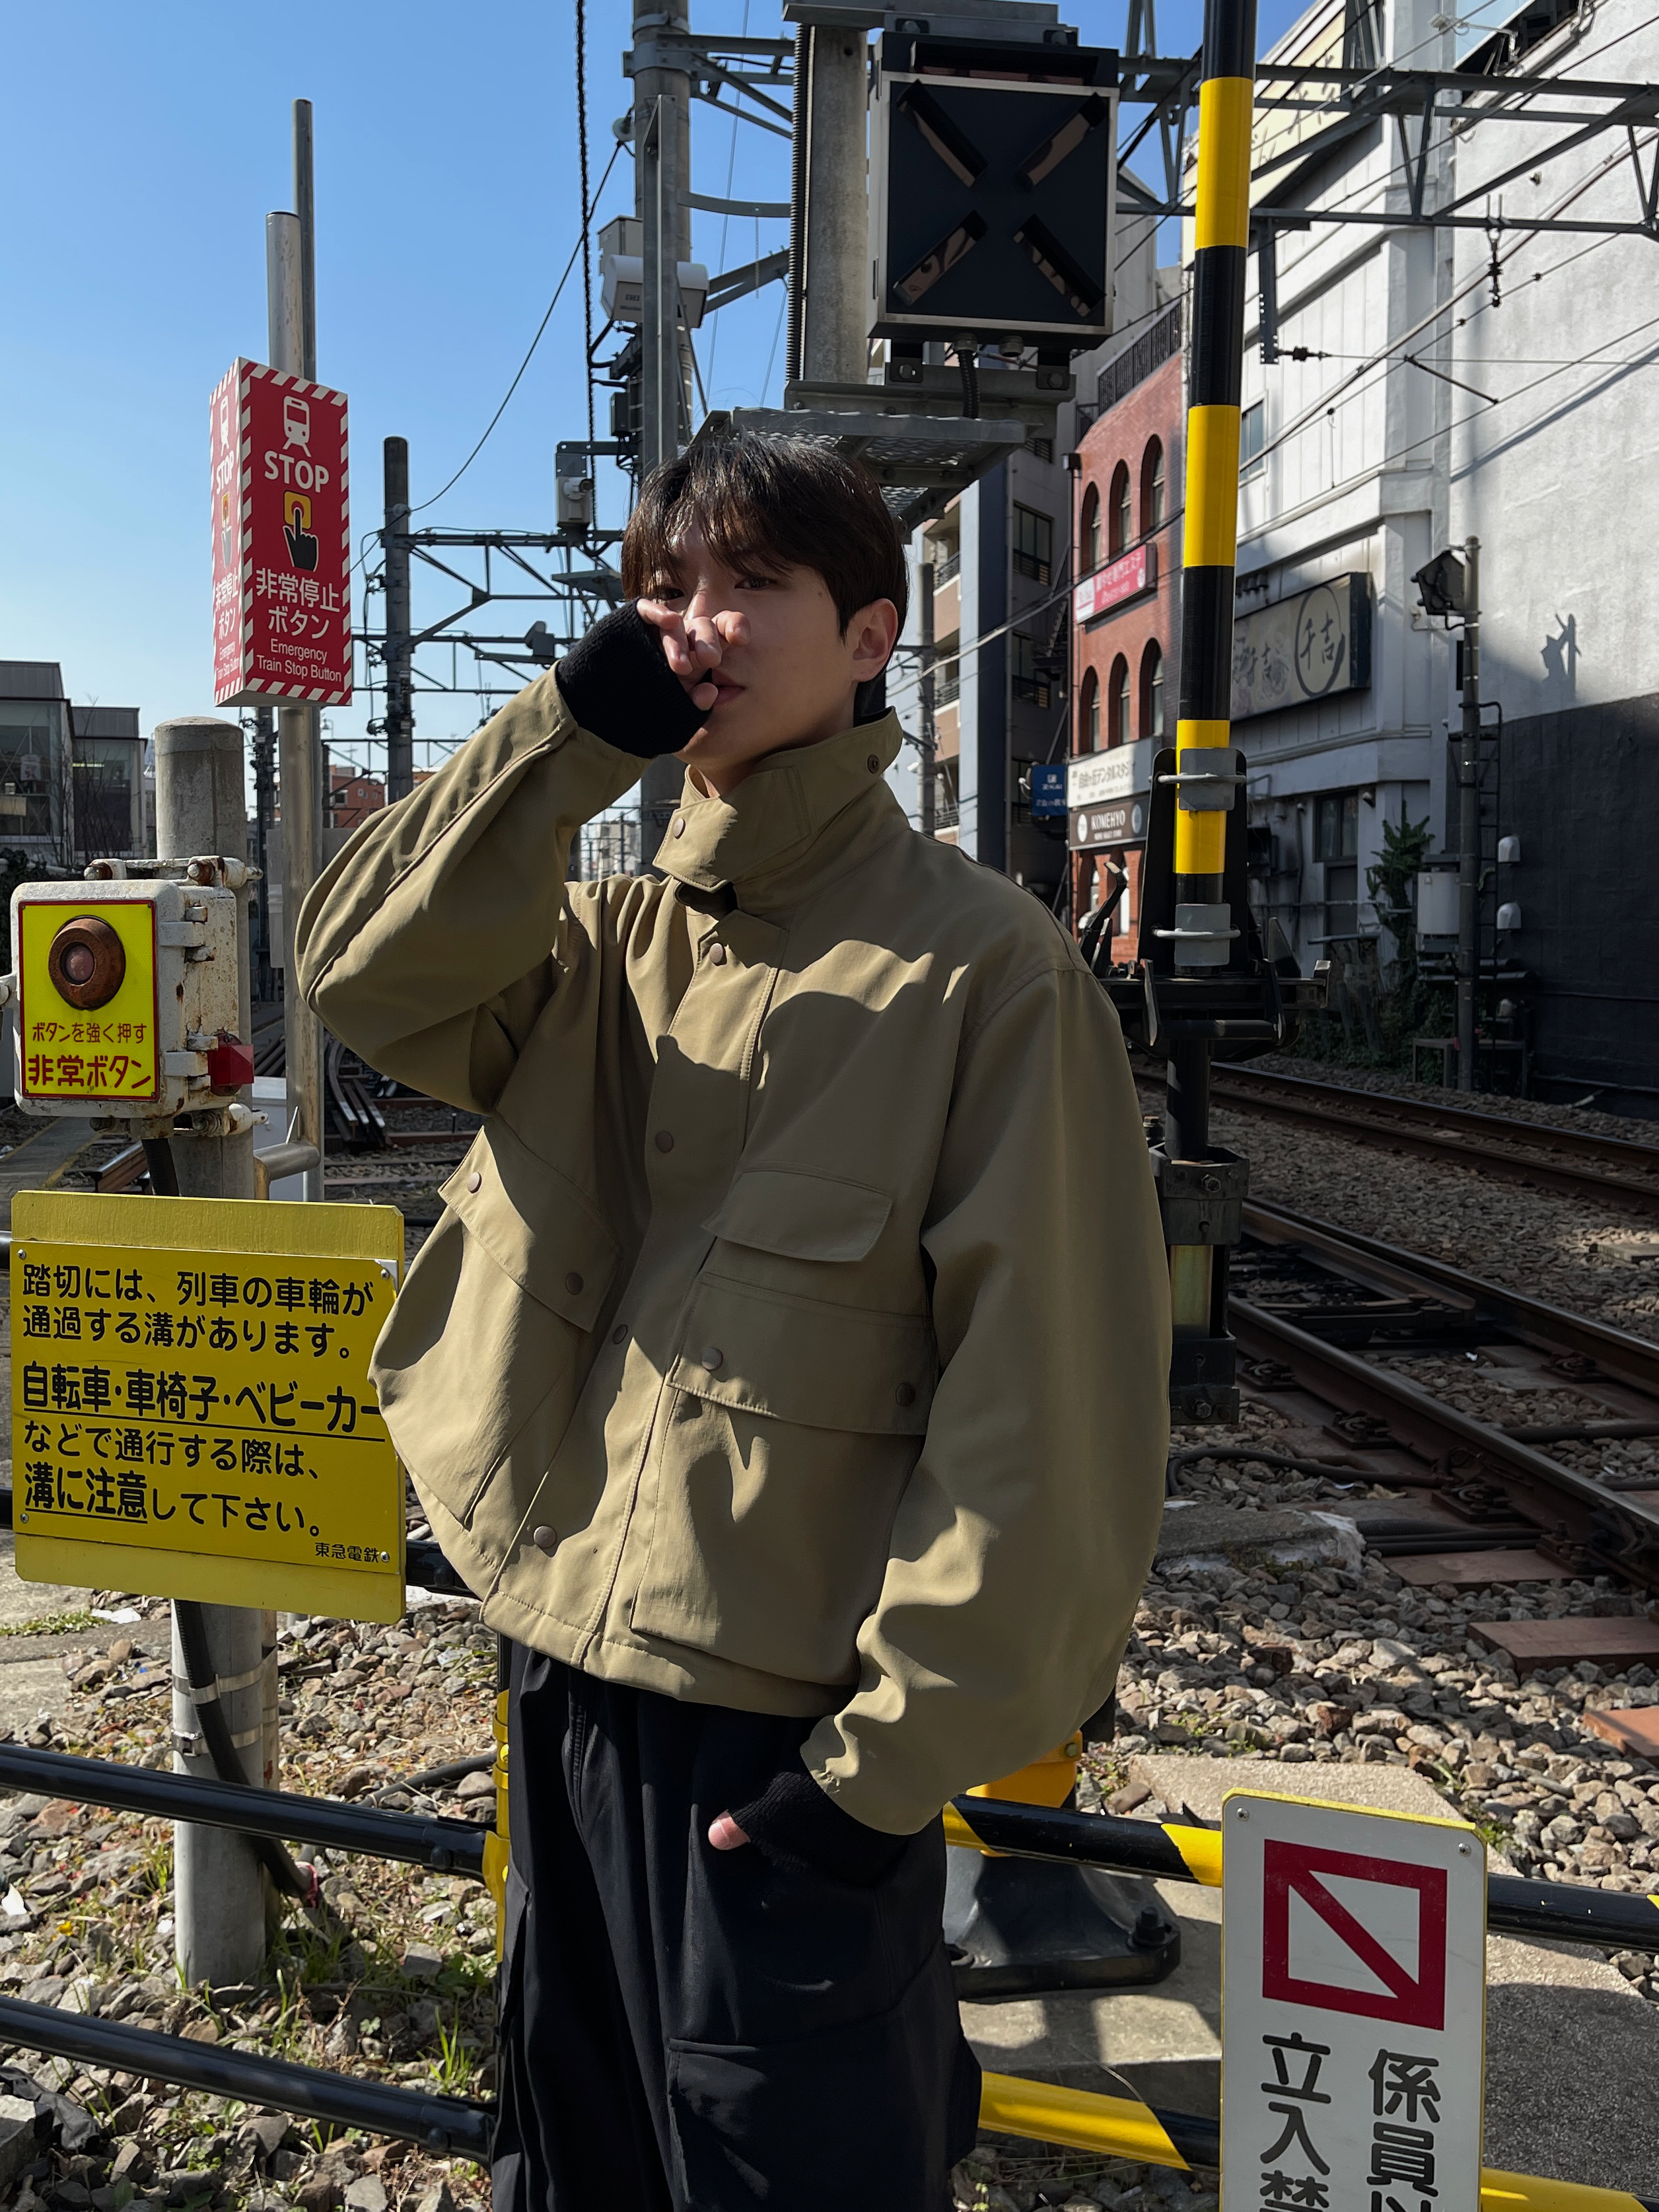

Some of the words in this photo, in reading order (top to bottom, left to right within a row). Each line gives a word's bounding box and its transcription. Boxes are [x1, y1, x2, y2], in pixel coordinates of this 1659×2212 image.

[217, 450, 234, 494] STOP
[264, 450, 330, 493] STOP
[216, 567, 238, 612] 非常停止
[256, 567, 340, 613] 非常停止
[219, 607, 236, 640] ボタン
[268, 605, 330, 639] ボタン
[256, 655, 282, 675] Train
[285, 659, 308, 682] Stop
[310, 663, 342, 683] Button
[270, 638, 328, 664] Emergency
[1091, 810, 1125, 831] KOMEHYO
[32, 1022, 147, 1044] ボタンを強く押す
[28, 1054, 151, 1088] 非常ボタン
[22, 1264, 374, 1317] 踏切には、列車の車輪が
[22, 1305, 351, 1359] 通過する溝があります。
[24, 1361, 382, 1433] 自転車・車椅子・ベビーカー
[24, 1421, 319, 1480] などで通行する際は、
[24, 1462, 321, 1537] 溝に注意して下さい。
[315, 1542, 379, 1563] 東急電鉄
